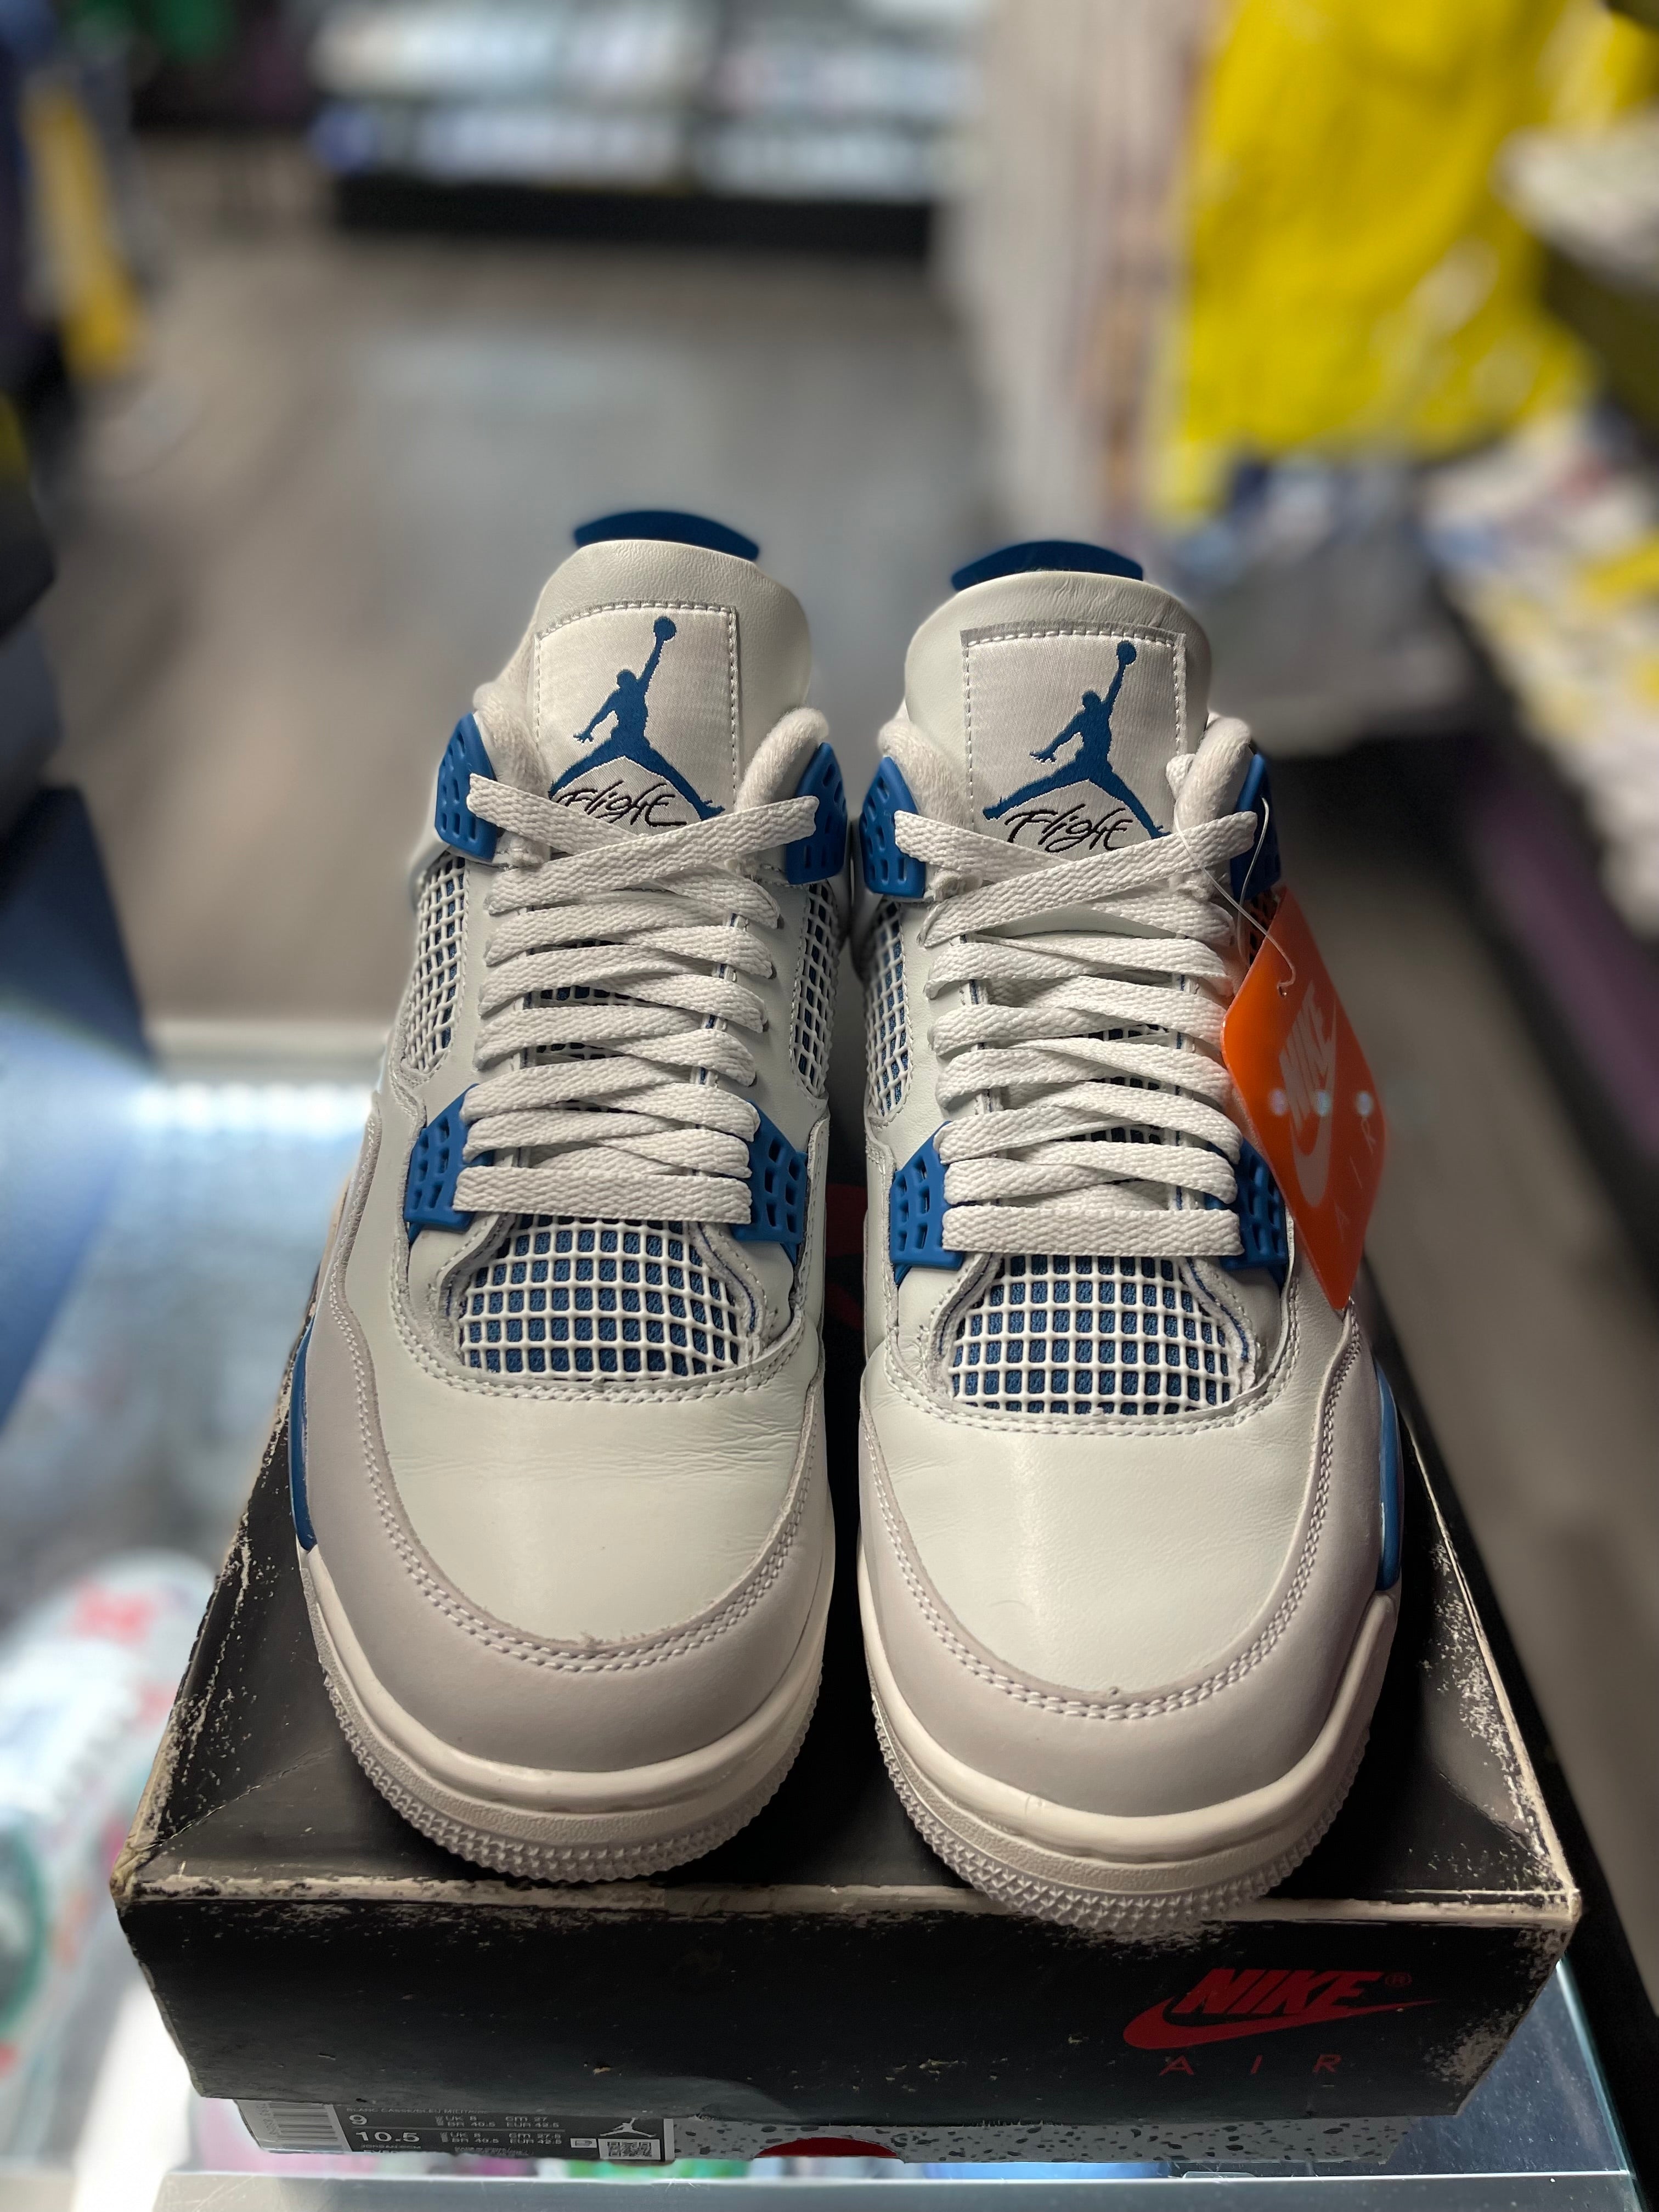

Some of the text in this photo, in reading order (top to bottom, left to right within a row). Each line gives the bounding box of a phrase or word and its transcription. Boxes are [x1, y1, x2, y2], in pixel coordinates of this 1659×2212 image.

[1005, 803, 1133, 853] Flight
[1171, 1968, 1383, 2015] NIKE
[1159, 2054, 1342, 2076] AIR
[349, 2114, 368, 2125] 9
[356, 2131, 420, 2142] 10.5
